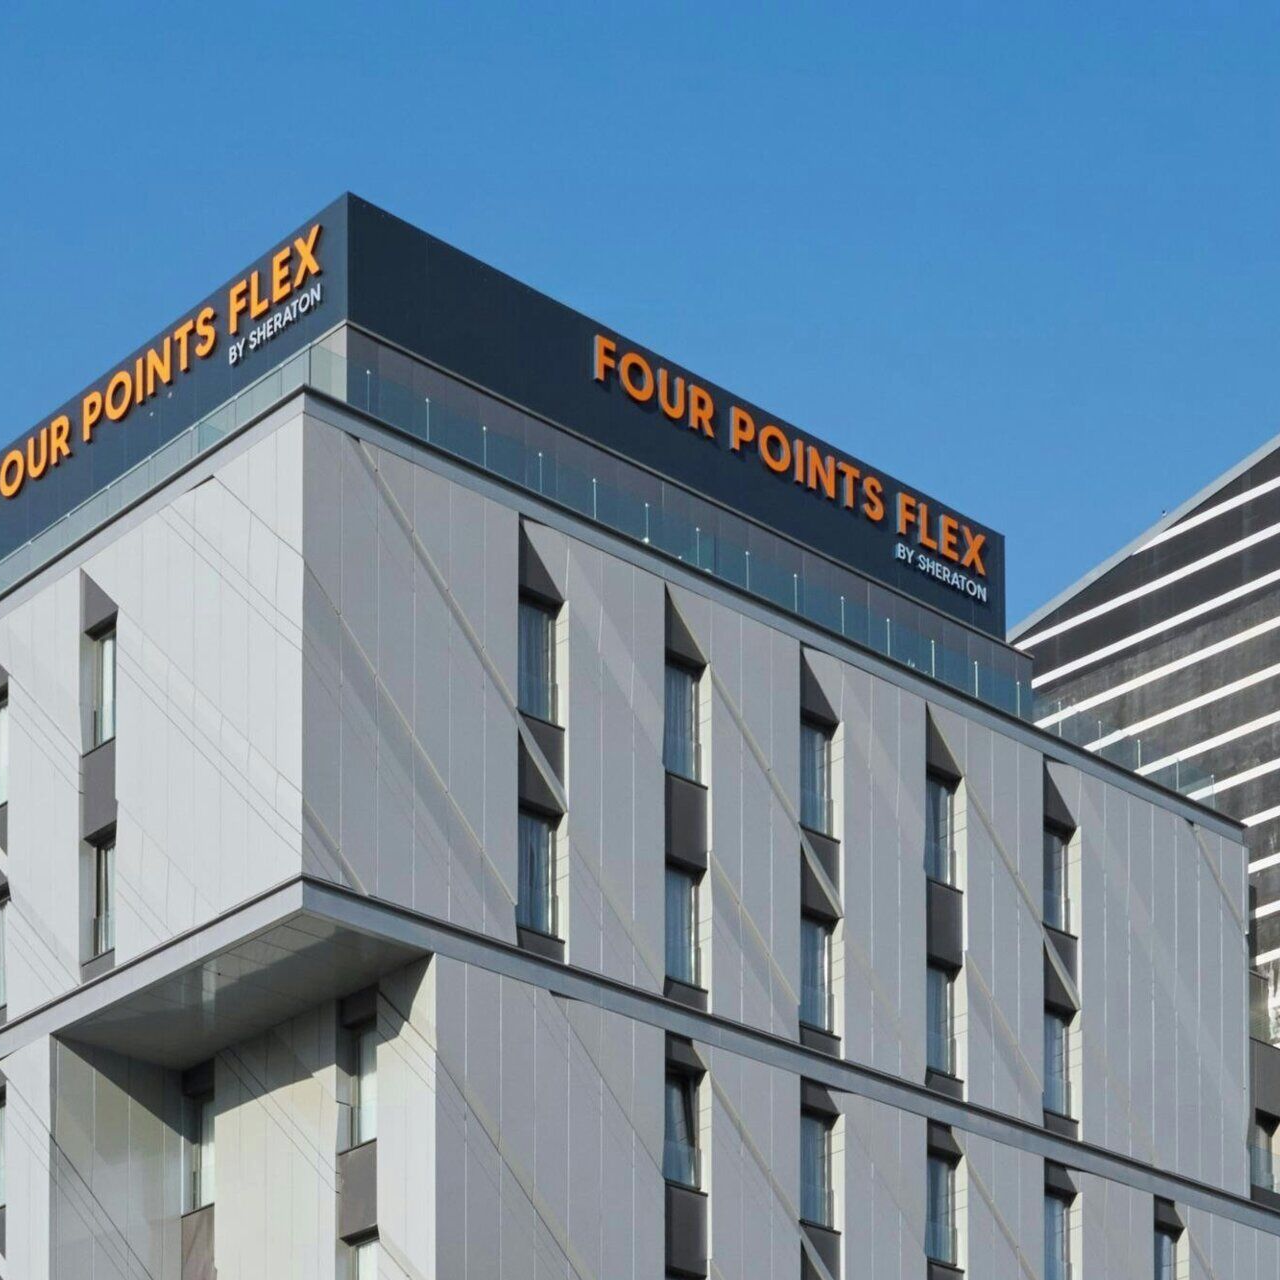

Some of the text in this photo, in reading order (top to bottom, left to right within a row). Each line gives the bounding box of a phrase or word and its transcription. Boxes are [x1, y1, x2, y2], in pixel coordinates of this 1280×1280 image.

[81, 306, 217, 442] POINTS
[228, 224, 321, 334] FLEX
[229, 283, 321, 365] BY SHERATON
[594, 334, 987, 576] FOUR POINTS FLEX
[896, 543, 987, 603] BY SHERATON
